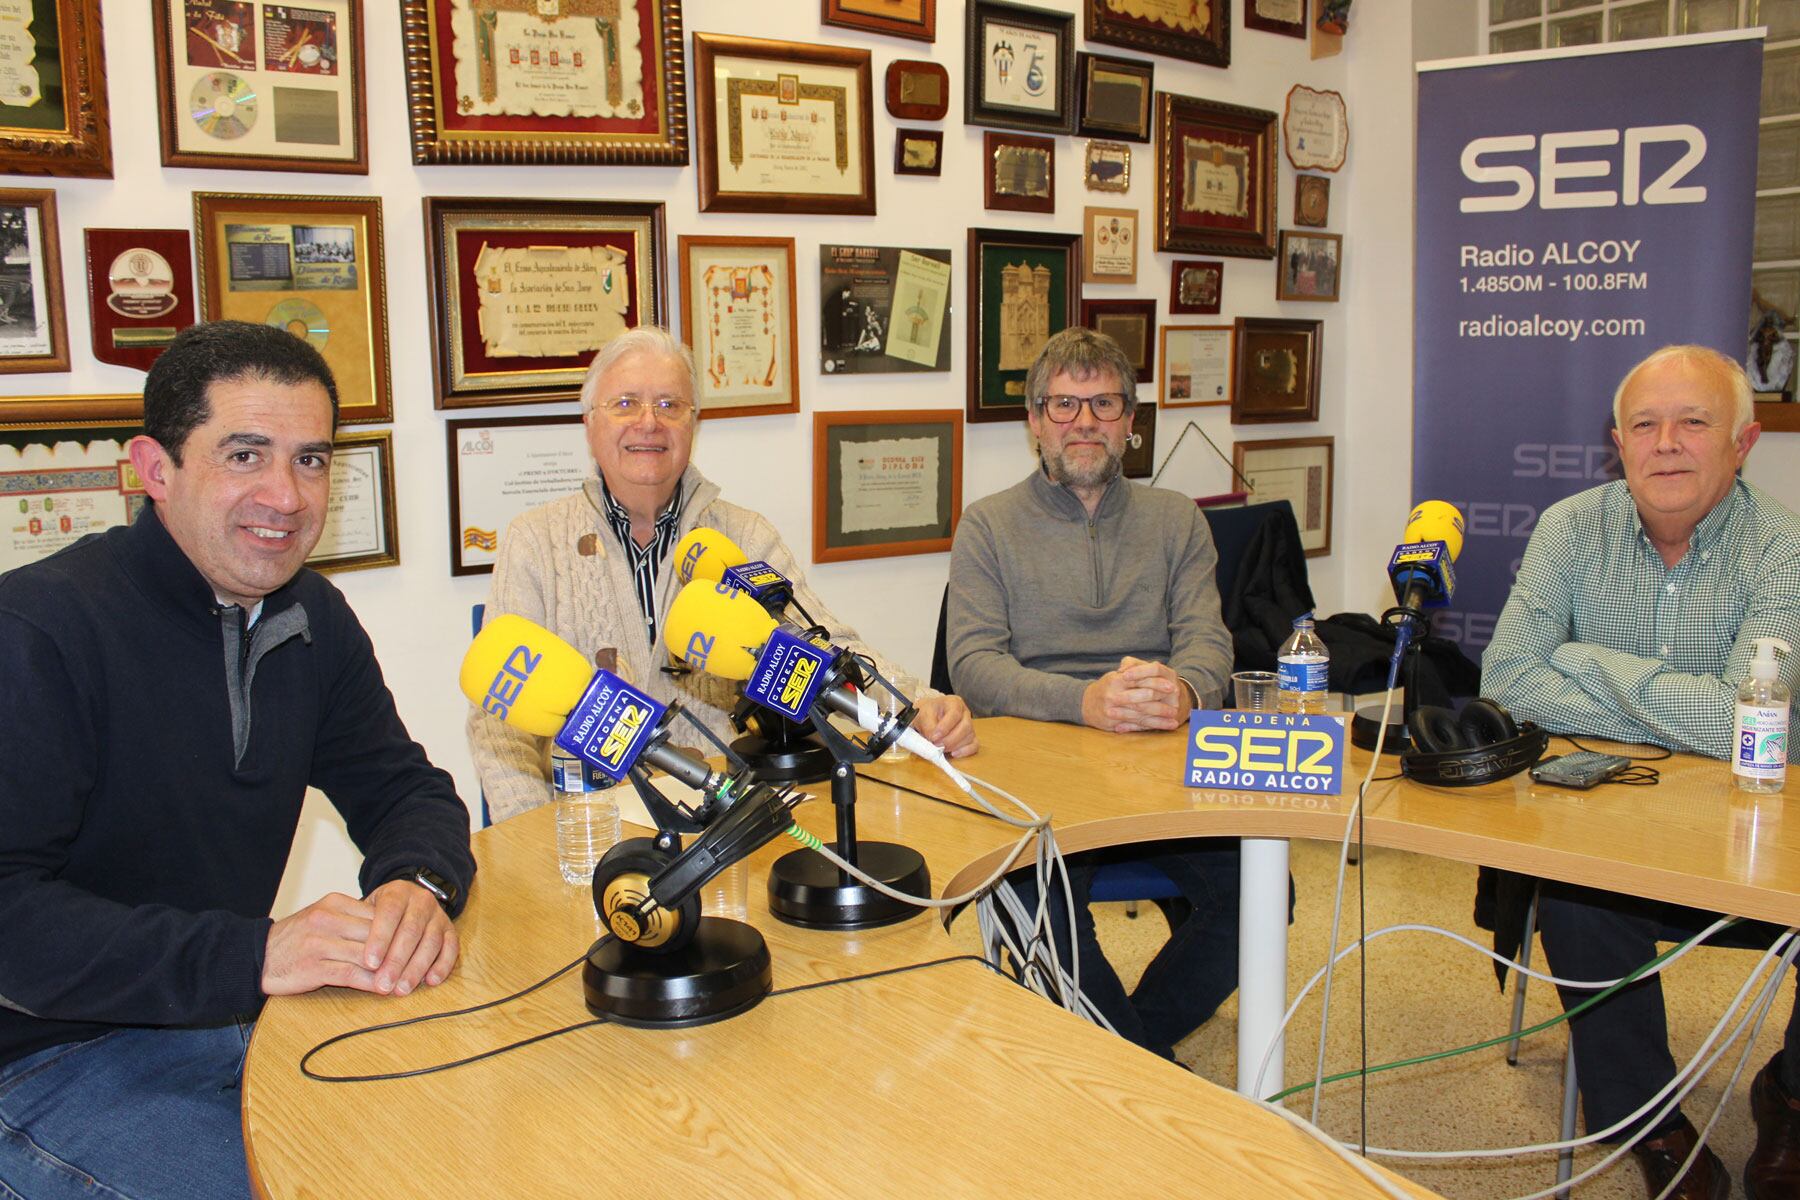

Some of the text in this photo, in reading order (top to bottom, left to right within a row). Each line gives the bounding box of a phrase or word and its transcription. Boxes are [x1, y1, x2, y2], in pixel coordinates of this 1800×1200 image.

[1460, 124, 1707, 213] SER
[1461, 240, 1641, 267] Radio ALCOY
[1563, 273, 1647, 291] 100.8FM
[1459, 314, 1646, 342] radioalcoy.com
[462, 441, 494, 451] ALCOI
[1512, 443, 1621, 479] SER
[482, 645, 543, 721] SER
[757, 643, 786, 695] RADIO ALCOY
[772, 651, 800, 701] CADENA
[780, 657, 818, 710] SER
[573, 685, 613, 744] RADIO ALCOY
[590, 697, 629, 753] CADENA
[600, 704, 649, 766] SER
[1223, 714, 1310, 726] CADENA
[1193, 726, 1334, 775] SER
[1191, 770, 1333, 791] RADIO ALCOY
